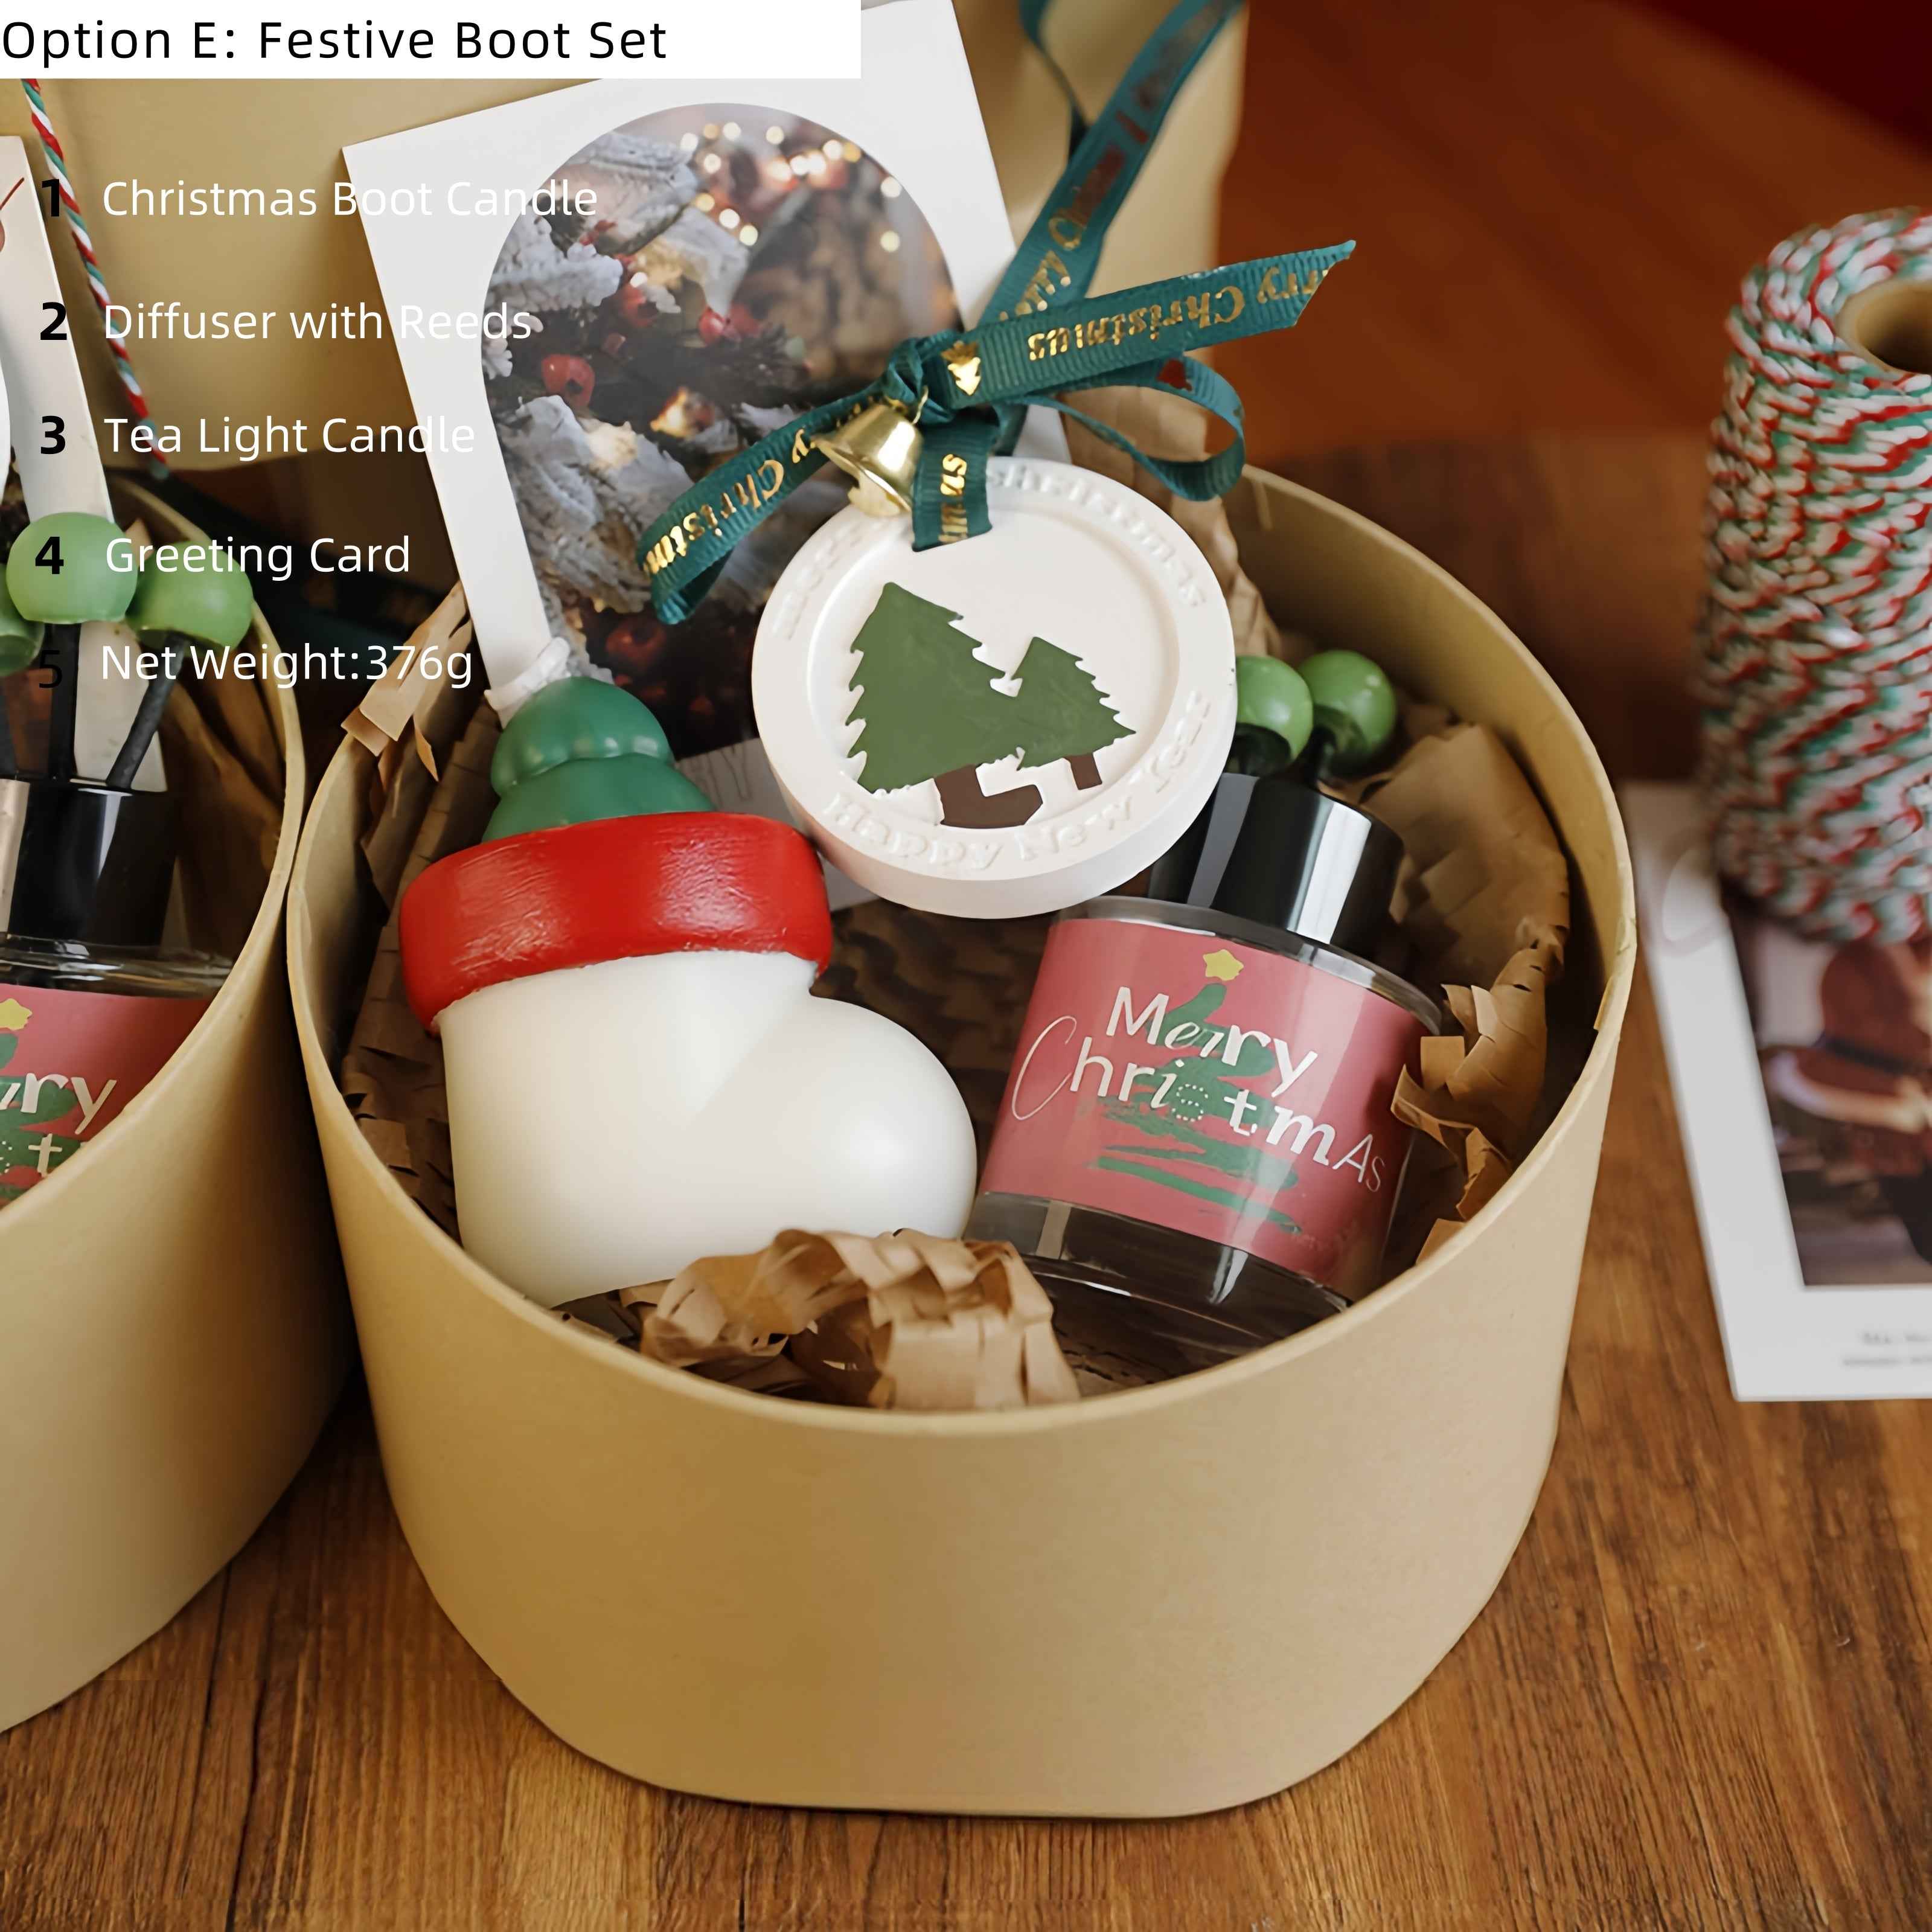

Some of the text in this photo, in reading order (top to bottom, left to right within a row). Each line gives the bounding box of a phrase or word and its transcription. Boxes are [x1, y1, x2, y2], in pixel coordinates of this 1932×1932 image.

[822, 792, 1003, 871] Happy
[1017, 802, 1136, 863] New
[1105, 987, 1318, 1098] Merry
